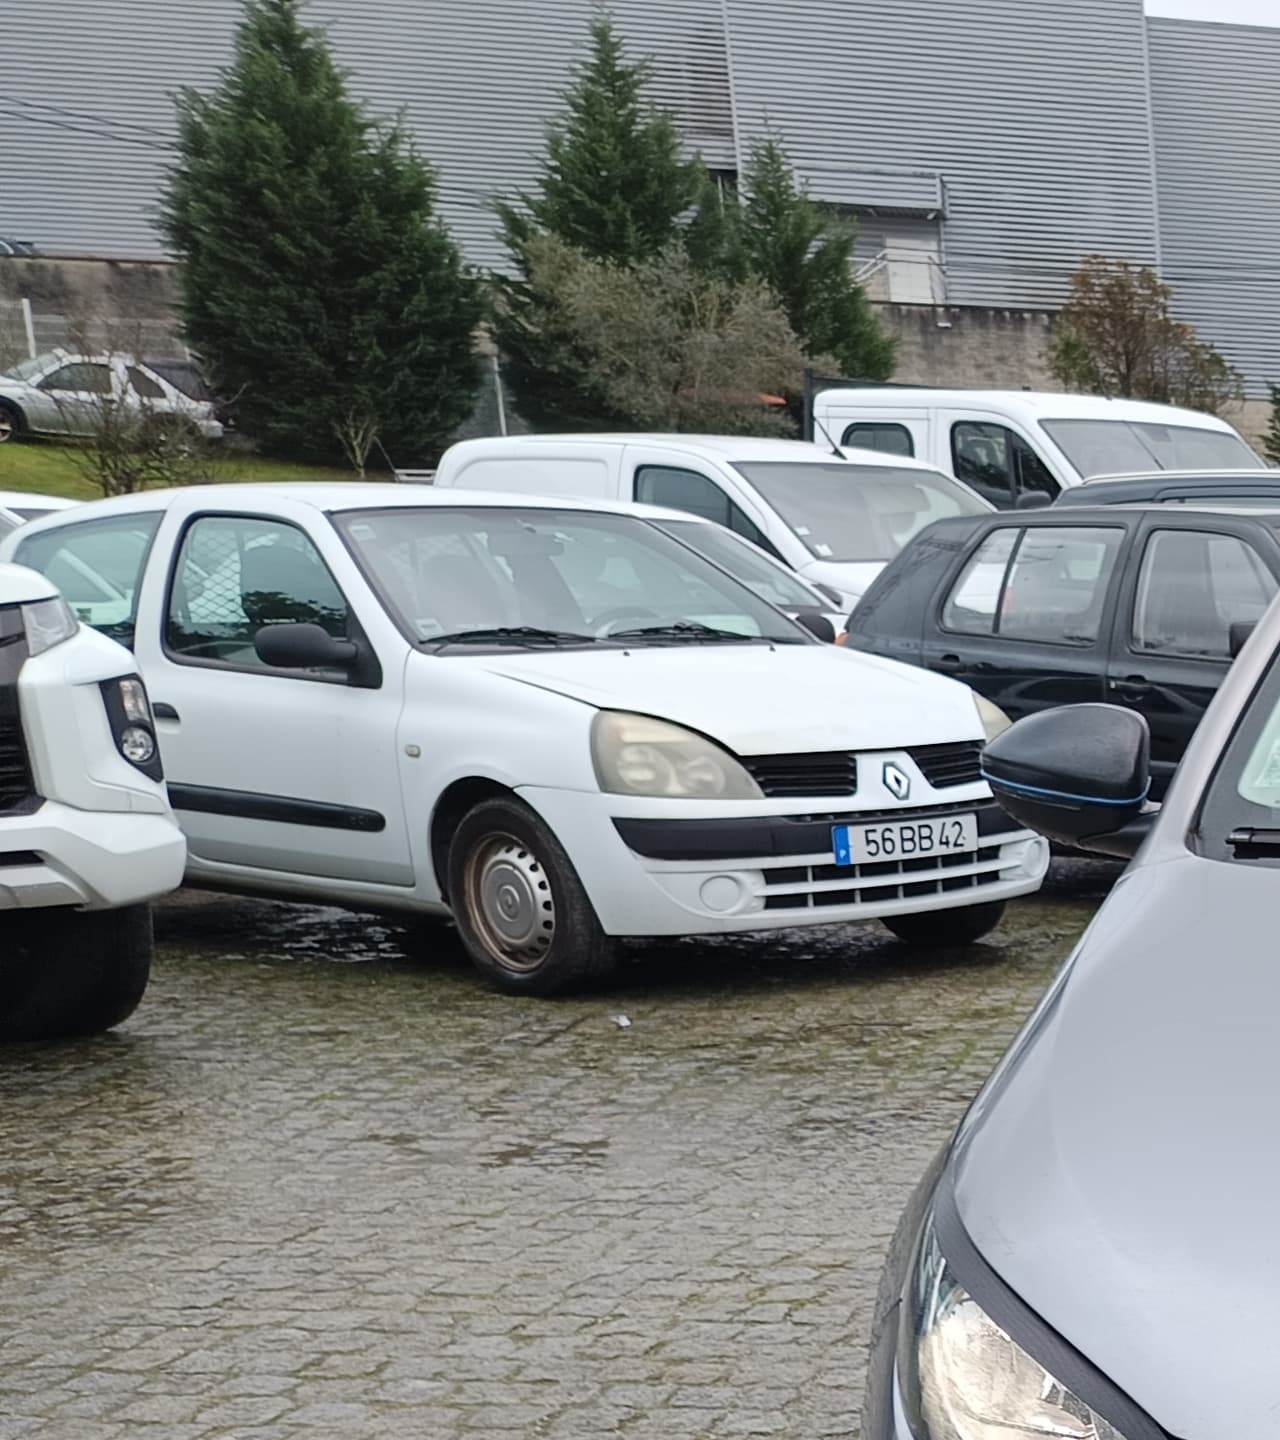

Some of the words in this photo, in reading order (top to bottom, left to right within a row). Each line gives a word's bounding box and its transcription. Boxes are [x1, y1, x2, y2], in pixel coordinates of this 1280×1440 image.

[864, 827, 896, 857] 56
[899, 823, 934, 855] BB
[938, 820, 965, 849] 42
